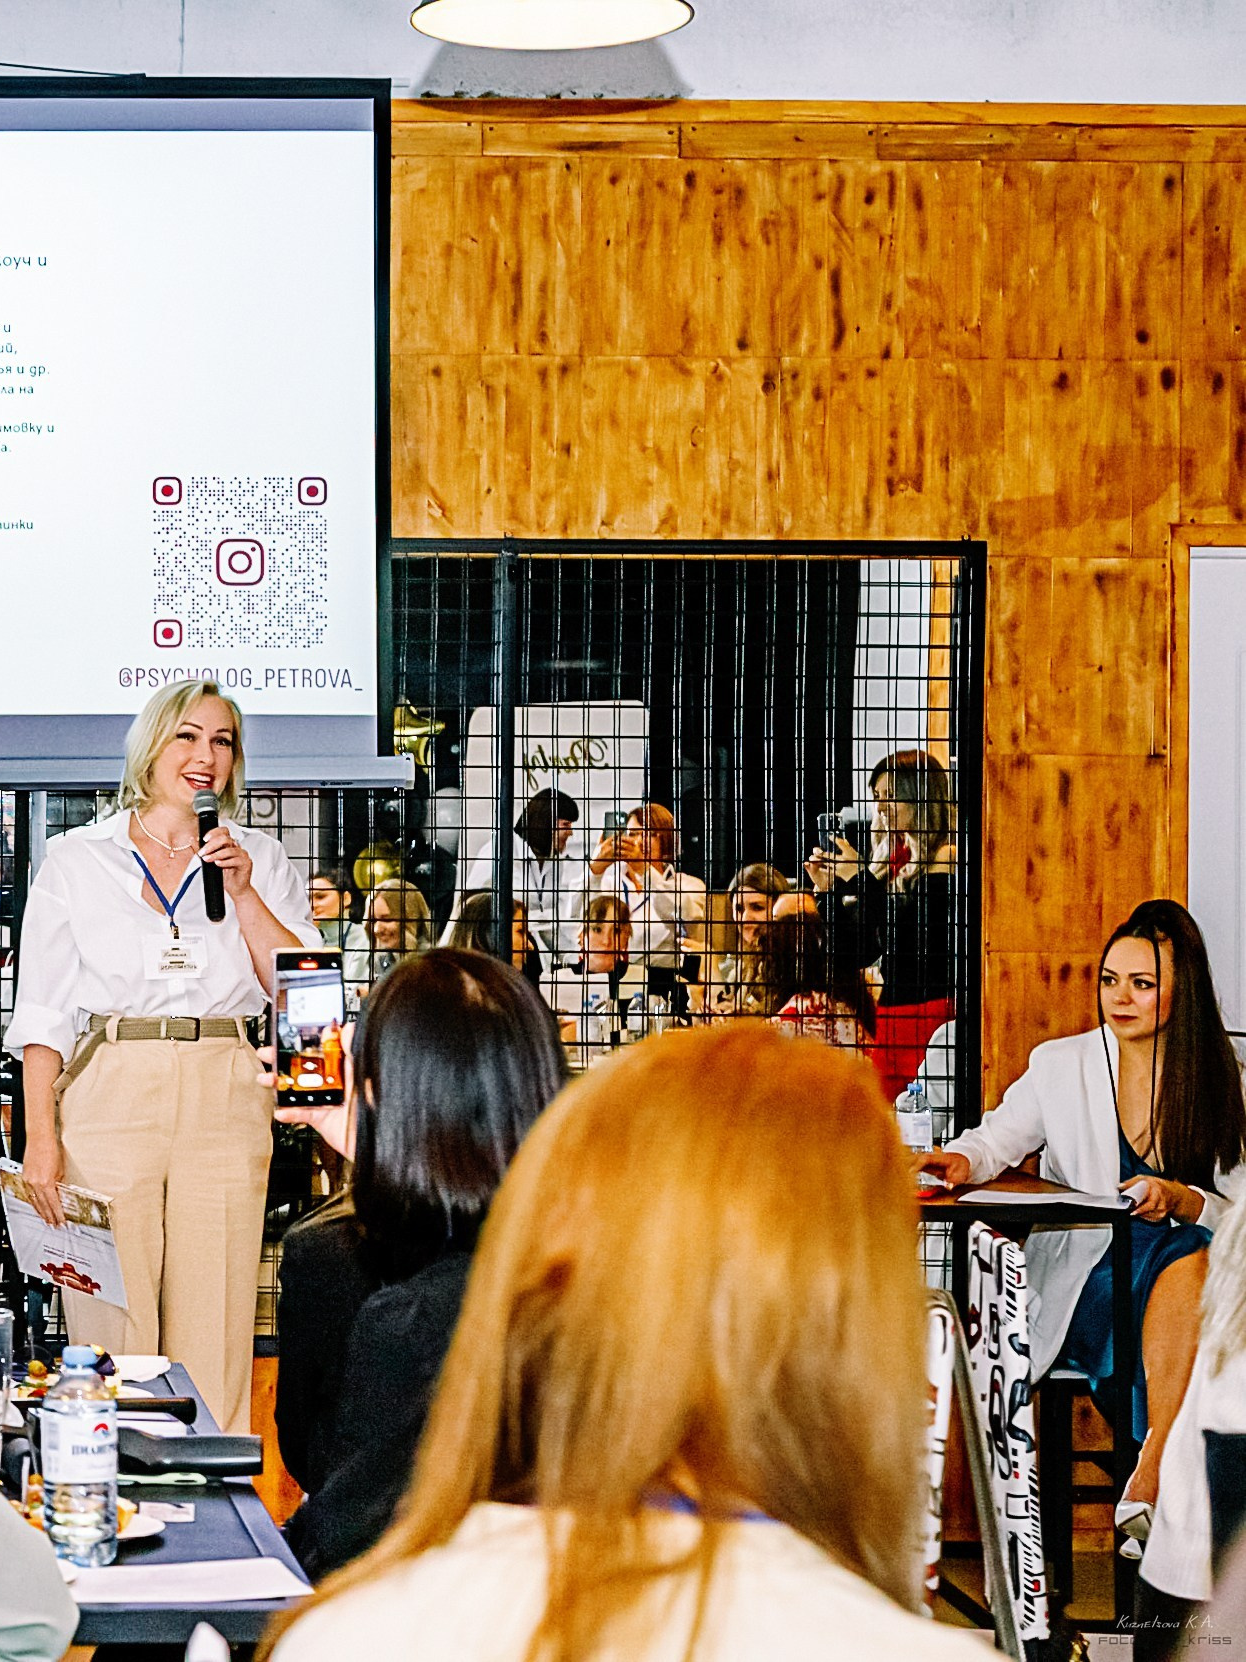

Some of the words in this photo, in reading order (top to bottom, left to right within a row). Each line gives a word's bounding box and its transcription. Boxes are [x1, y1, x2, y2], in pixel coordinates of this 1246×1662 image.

[36, 256, 48, 268] и
[2, 323, 12, 334] и
[15, 365, 25, 376] и
[28, 364, 50, 378] др.
[18, 385, 35, 396] на
[46, 424, 55, 433] и
